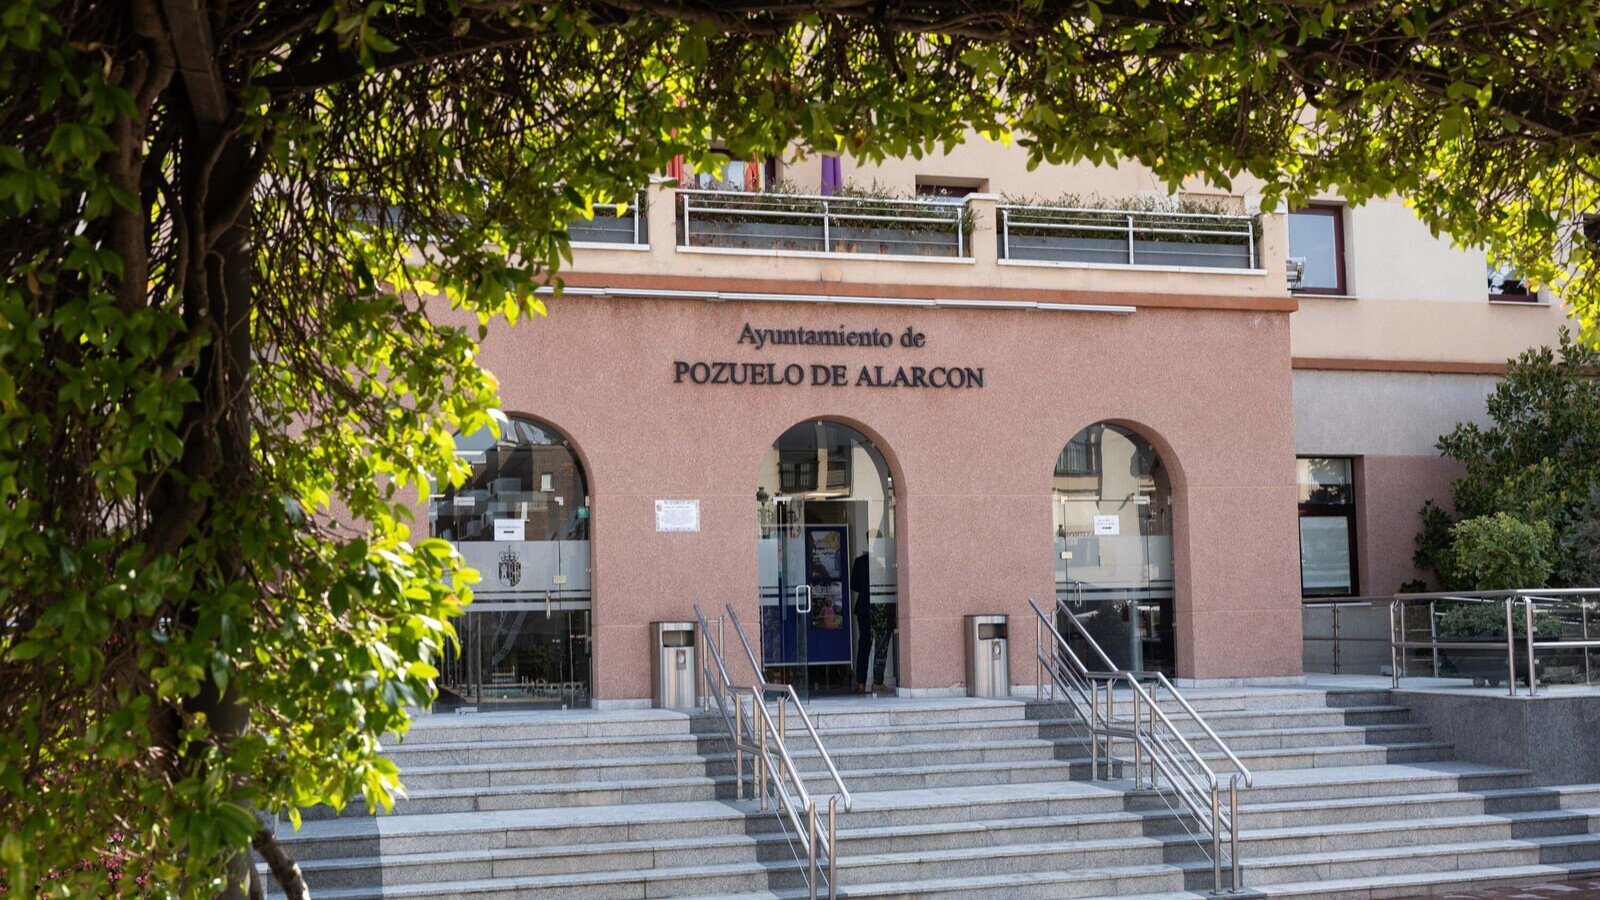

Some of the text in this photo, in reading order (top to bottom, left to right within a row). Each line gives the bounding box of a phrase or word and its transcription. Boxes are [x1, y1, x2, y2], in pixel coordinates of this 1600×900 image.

[737, 322, 926, 349] Ayuntamiento de
[674, 361, 984, 389] POZUELO DE ALARCON
